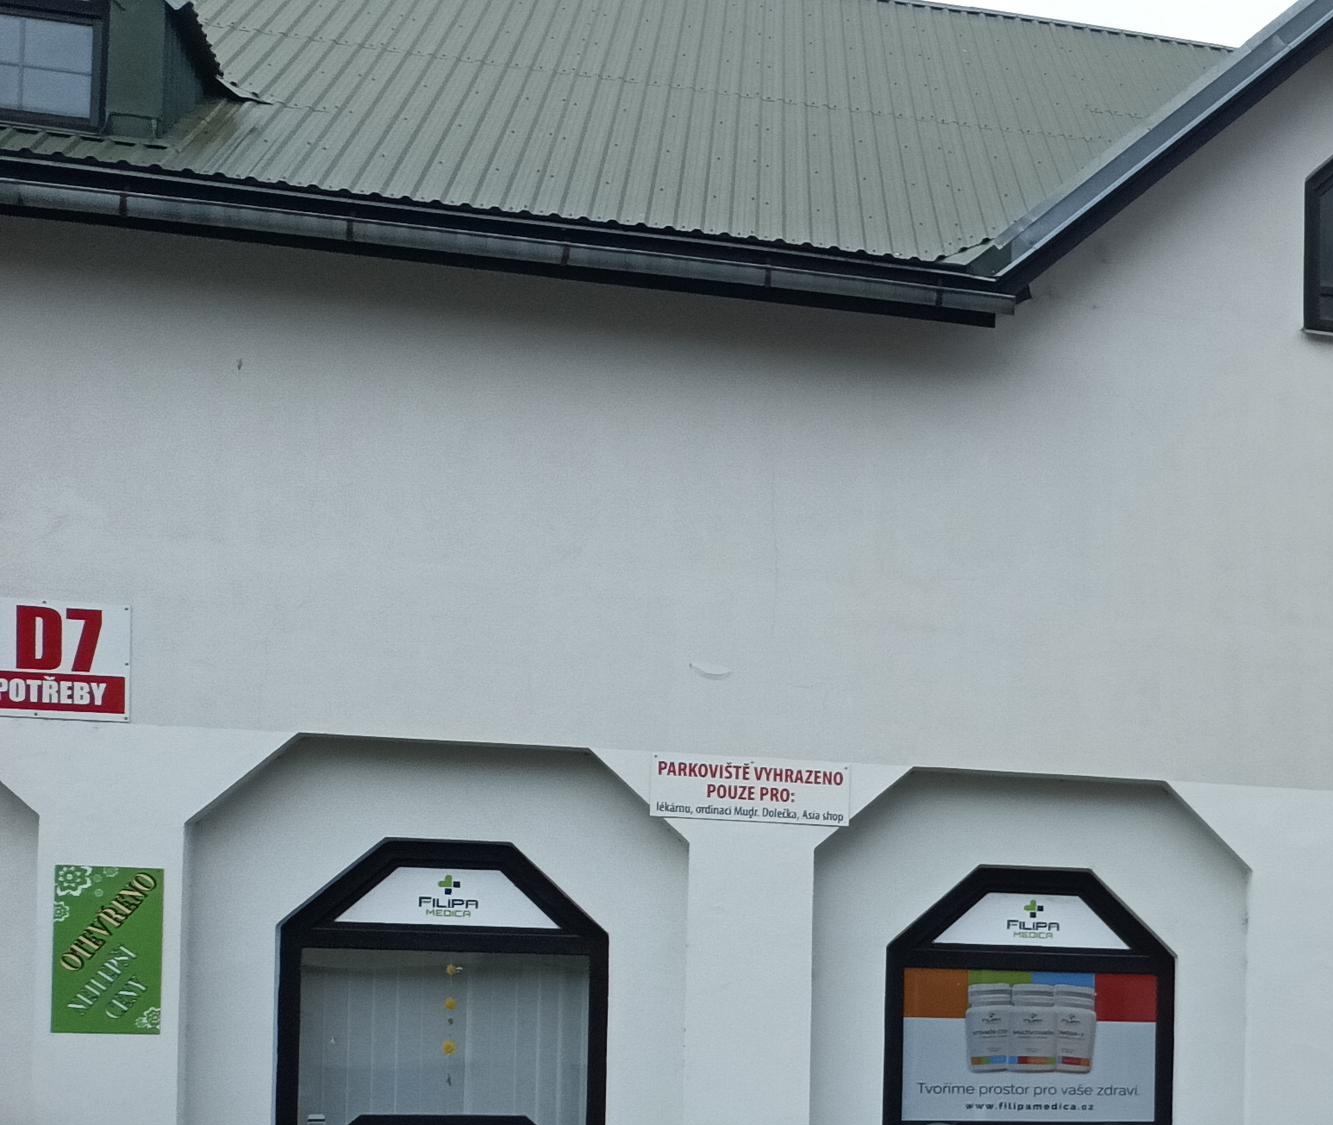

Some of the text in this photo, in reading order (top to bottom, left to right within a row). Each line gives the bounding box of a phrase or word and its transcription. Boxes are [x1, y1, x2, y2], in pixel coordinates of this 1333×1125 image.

[16, 605, 103, 672] D7
[658, 761, 844, 786] PARKOVIŠTĚ VYHRAZENO
[707, 784, 795, 802] POUZE PRO:
[802, 810, 820, 820] Asia
[822, 810, 844, 823] shop
[418, 896, 479, 909] FILIPA
[426, 909, 471, 918] MEDICA
[60, 872, 157, 971] OTEVŘENO
[1006, 920, 1060, 931] FILIPA
[916, 1082, 974, 1094] Tvoříme
[978, 1084, 1028, 1097] prostor
[1034, 1086, 1056, 1098] pro
[1061, 1085, 1093, 1096] vaše
[965, 1102, 1094, 1111] www.filipamedica.cz
